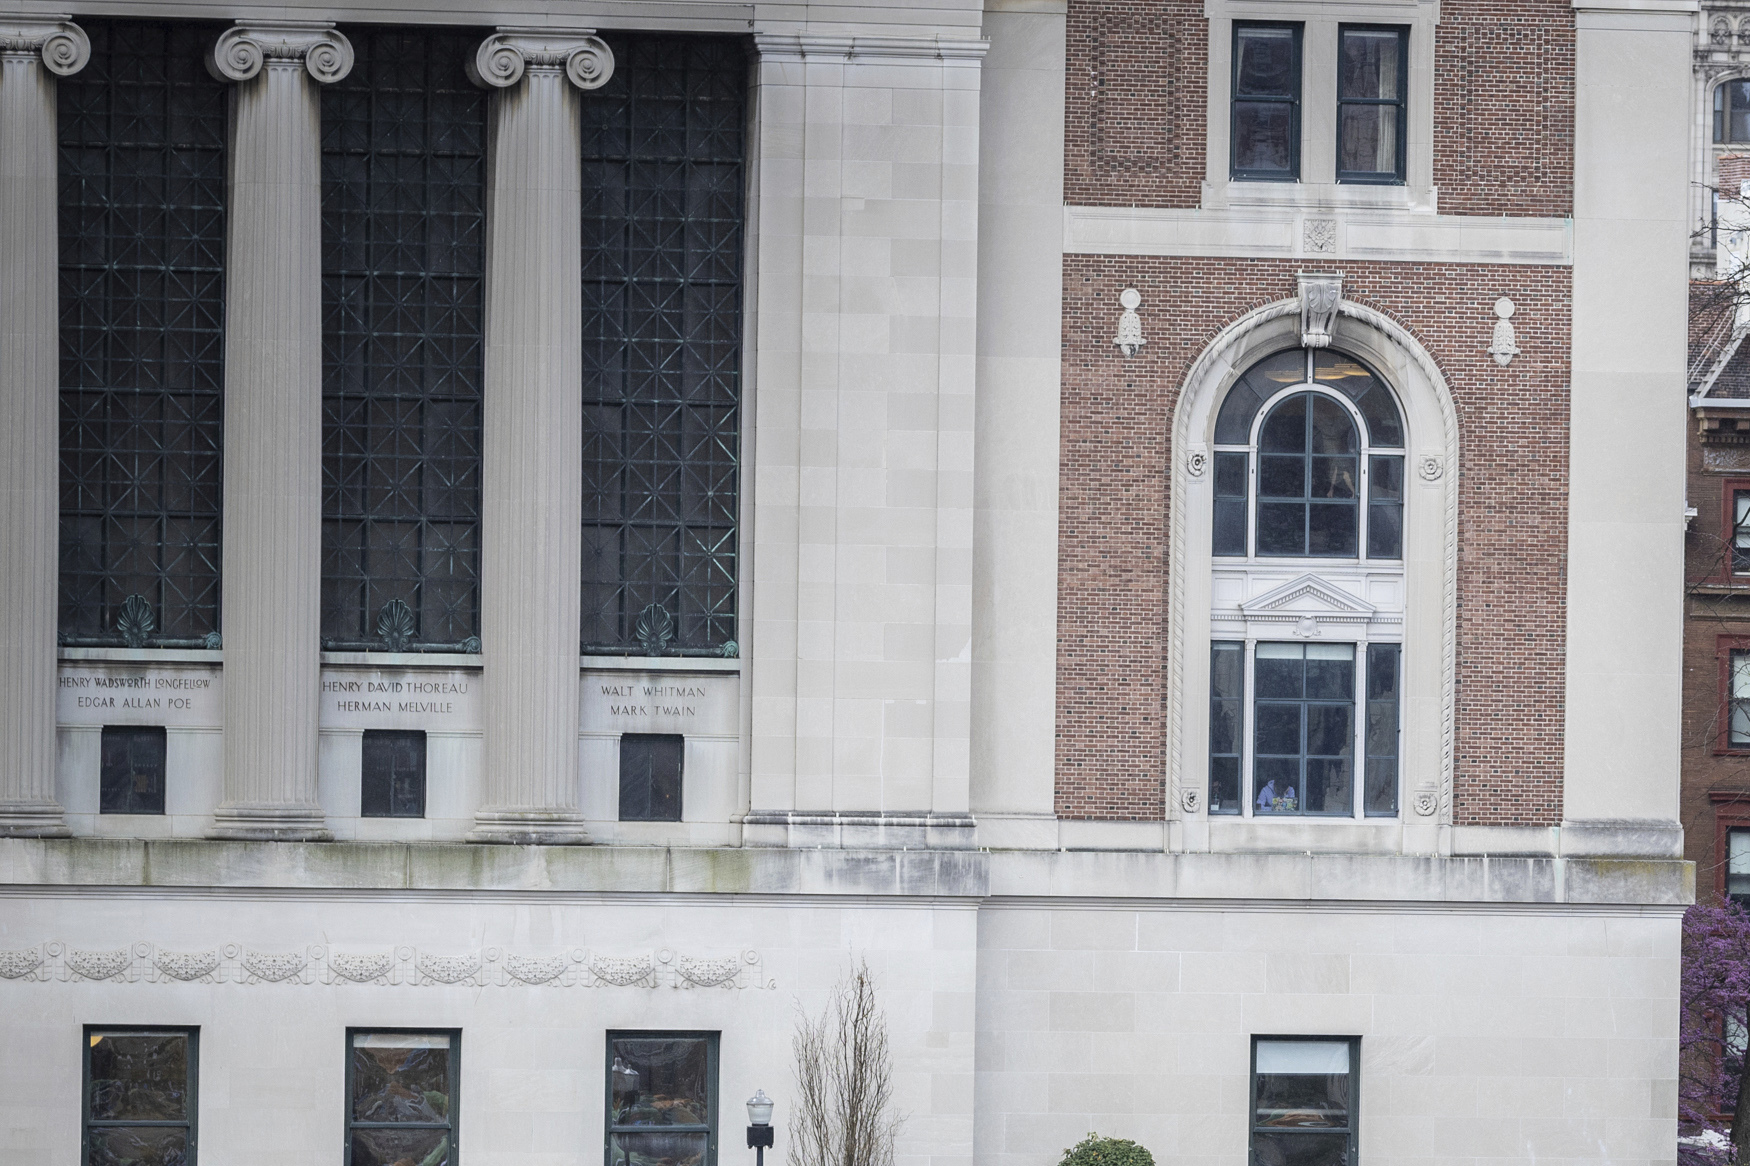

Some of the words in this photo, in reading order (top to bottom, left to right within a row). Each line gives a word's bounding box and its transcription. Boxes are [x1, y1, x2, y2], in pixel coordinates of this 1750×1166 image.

[59, 676, 91, 688] HENRY
[94, 676, 151, 689] WADSWORTH
[155, 678, 211, 690] LONGFELLOW
[322, 681, 363, 693] HENRY
[367, 682, 403, 693] DAVID
[406, 682, 468, 694] THOREAU
[601, 685, 634, 697] WALT
[643, 686, 706, 697] WHITMAN
[78, 696, 116, 708] EDGAR
[122, 698, 161, 709] ALLAN
[168, 698, 192, 709] POE
[337, 701, 392, 712] HERMAN
[398, 702, 453, 713] MELVILLE
[610, 705, 647, 716] MARK
[654, 705, 696, 716] TWAIN
